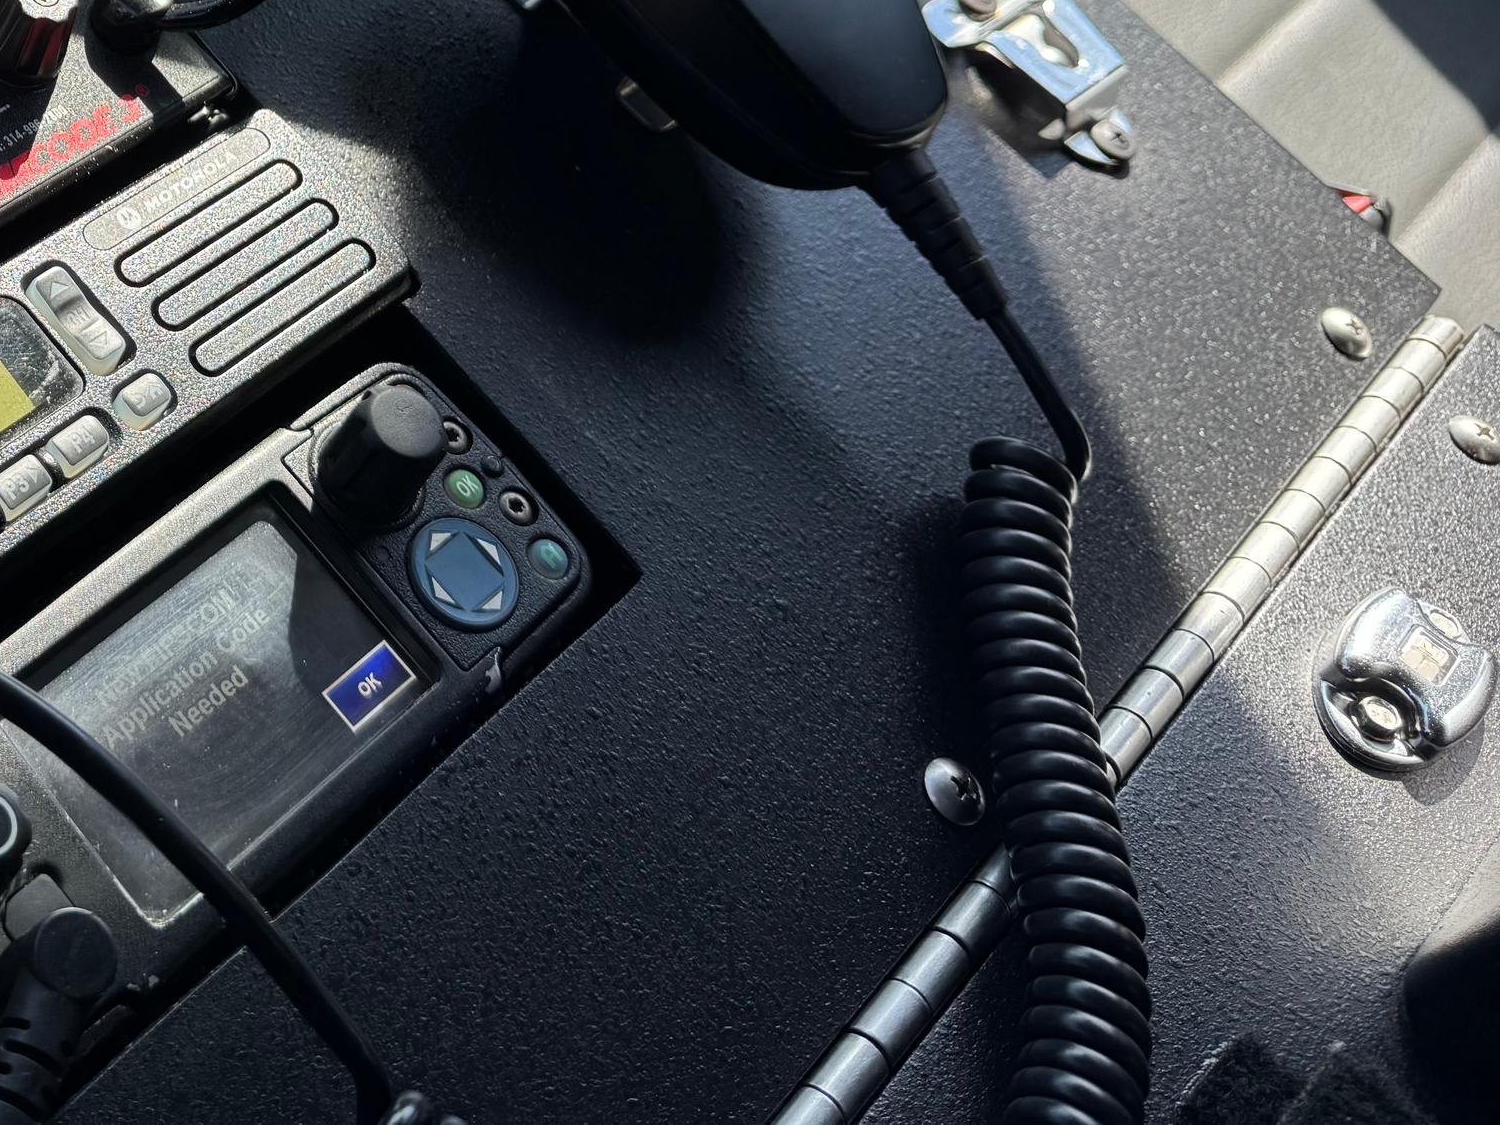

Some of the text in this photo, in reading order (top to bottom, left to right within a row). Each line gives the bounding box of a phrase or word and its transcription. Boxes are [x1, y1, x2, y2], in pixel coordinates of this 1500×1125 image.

[30, 103, 118, 174] CODE
[143, 151, 238, 213] MOTOROLA
[67, 432, 94, 454] P4
[4, 473, 31, 501] P3
[455, 474, 479, 496] OK
[102, 608, 270, 750] Application Code
[167, 664, 249, 738] Needed
[357, 671, 382, 699] OK
